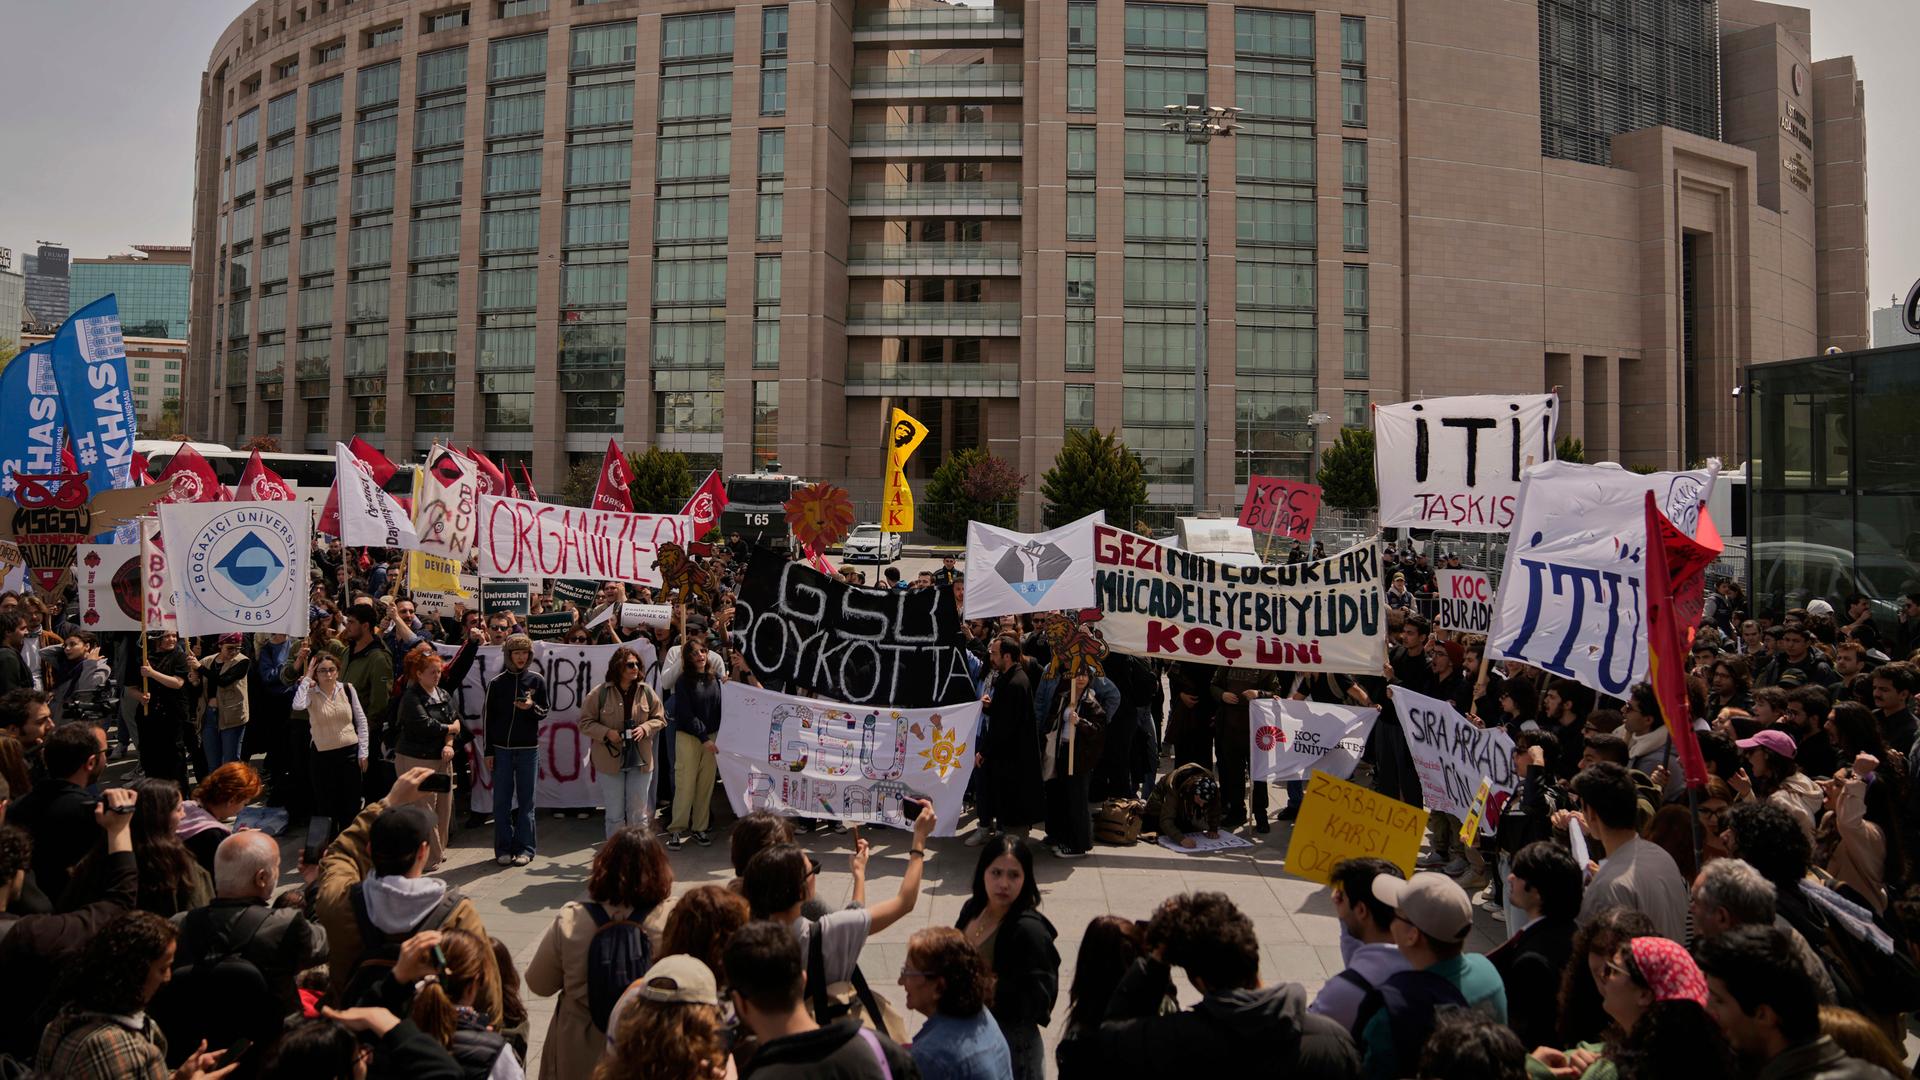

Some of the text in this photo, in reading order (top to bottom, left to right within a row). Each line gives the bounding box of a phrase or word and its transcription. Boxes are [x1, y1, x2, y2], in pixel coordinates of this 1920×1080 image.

[88, 363, 131, 467] KHAS
[744, 514, 769, 526] T 65
[1253, 484, 1309, 513] KOÇ
[192, 510, 297, 584] BOĞAZİÇİ ÜNİVERSİTESİ
[1451, 575, 1488, 603] KOÇ
[233, 609, 272, 621] 1863
[1503, 531, 1640, 695] İTÜ
[1147, 620, 1242, 666] KOÇ
[1294, 730, 1321, 744] KOÇ
[1409, 707, 1450, 753] SIRA
[1311, 776, 1419, 837] ZORBALIĞA
